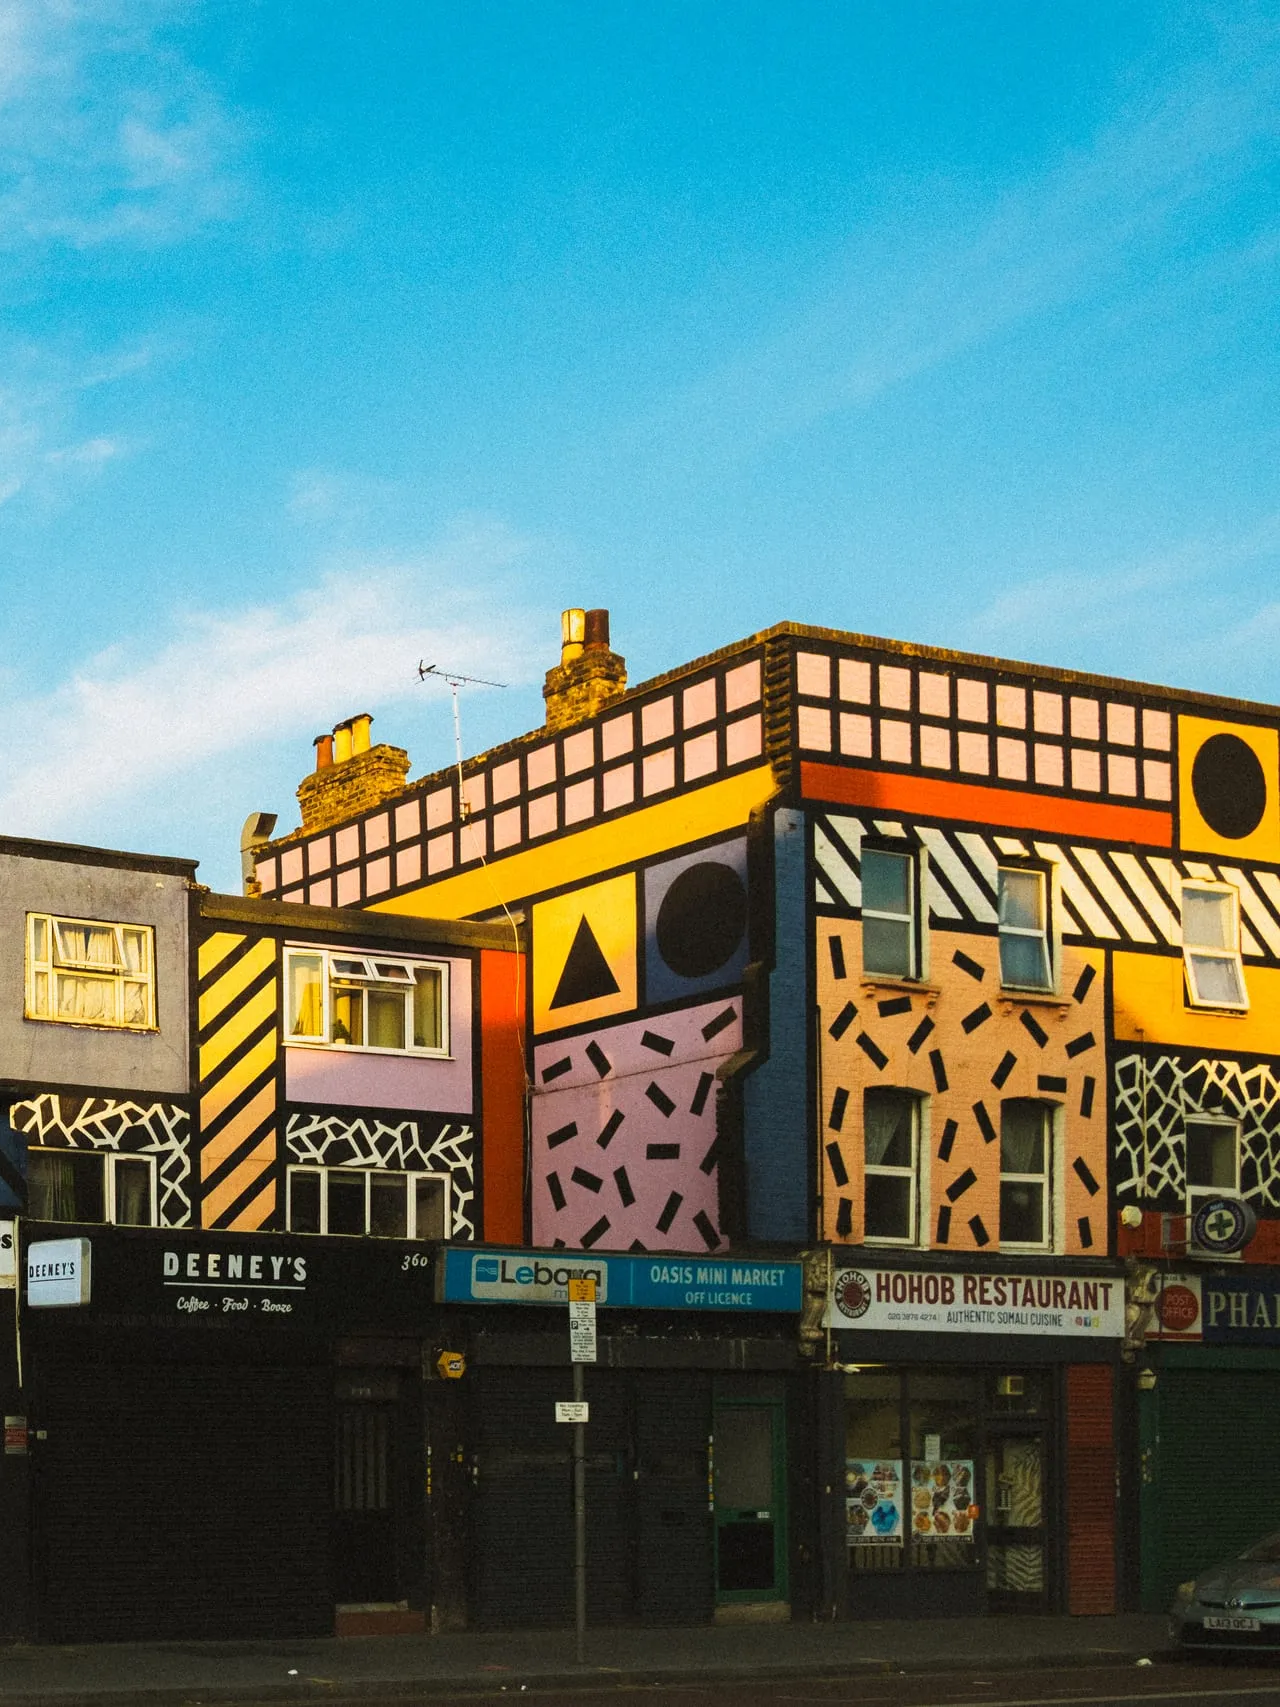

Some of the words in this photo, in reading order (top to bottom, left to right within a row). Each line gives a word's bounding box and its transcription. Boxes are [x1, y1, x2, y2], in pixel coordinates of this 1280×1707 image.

[29, 1262, 75, 1278] DEENEY'S
[163, 1252, 307, 1282] DEENEY'S
[401, 1253, 428, 1271] 360
[650, 1265, 693, 1284] OASIS
[696, 1267, 727, 1285] MINI
[731, 1268, 785, 1287] MARKET
[685, 1291, 705, 1304] OFF
[707, 1292, 753, 1305] LICENCE
[876, 1273, 955, 1305] HOHOB
[963, 1275, 1113, 1311] RESTAURANT
[1166, 1294, 1190, 1306] POST
[176, 1296, 209, 1312] Coffee
[222, 1297, 249, 1313] Food
[261, 1299, 293, 1313] Booze
[1162, 1307, 1194, 1318] OFFICE
[946, 1309, 994, 1324] AUTHENTIC
[997, 1311, 1028, 1326] SOMALI
[1030, 1313, 1063, 1327] CUISINE
